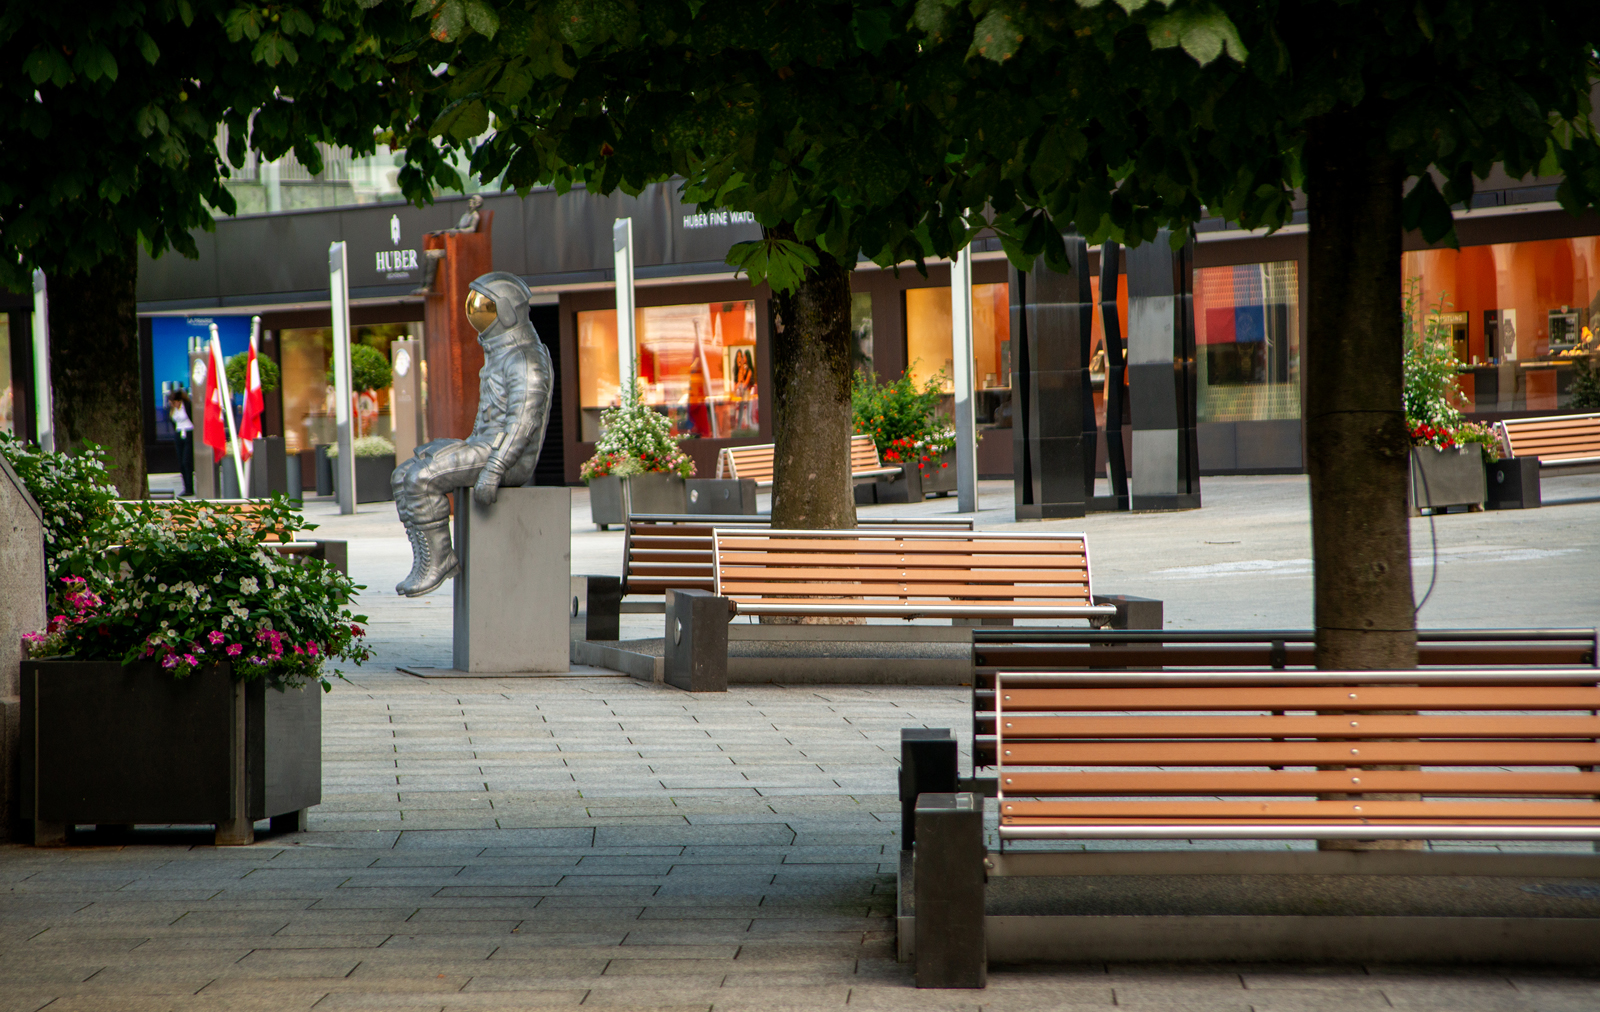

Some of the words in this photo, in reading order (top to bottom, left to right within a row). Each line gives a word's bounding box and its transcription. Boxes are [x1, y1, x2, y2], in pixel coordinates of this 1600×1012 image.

[683, 214, 708, 228] HUBER
[709, 212, 727, 226] FINE
[375, 249, 418, 272] HUBER
